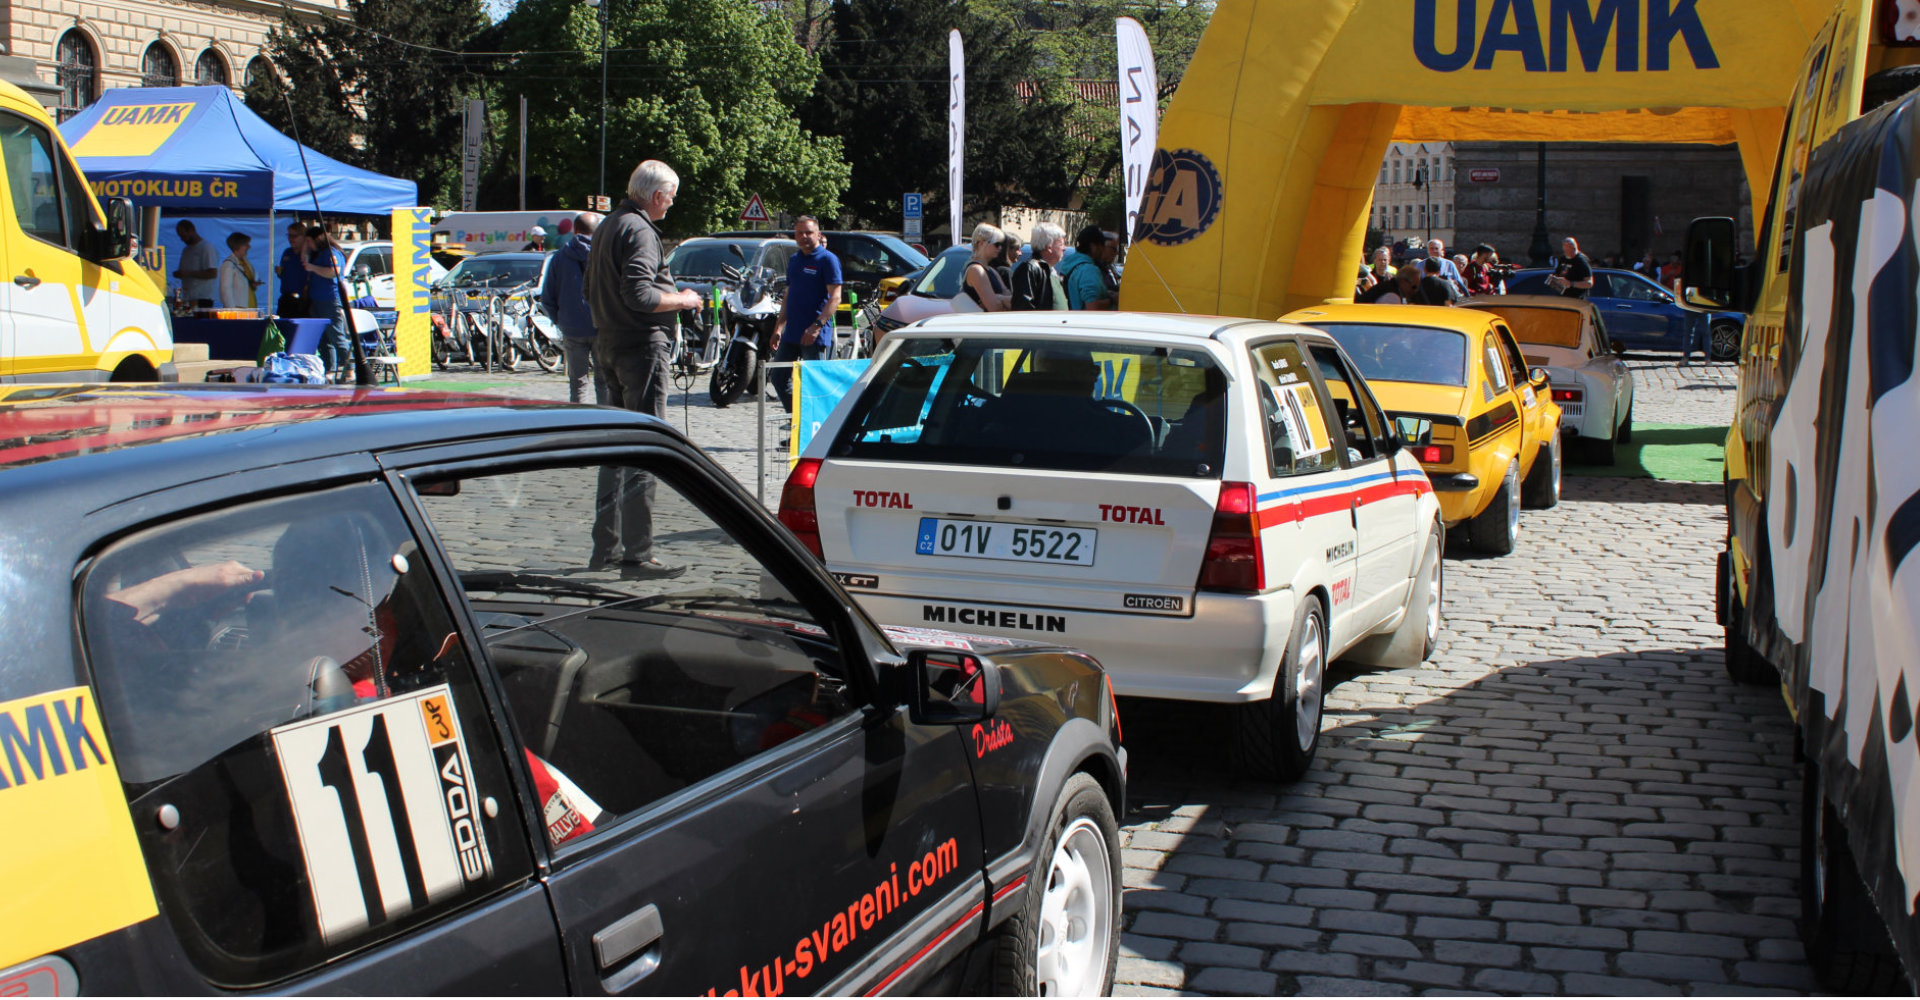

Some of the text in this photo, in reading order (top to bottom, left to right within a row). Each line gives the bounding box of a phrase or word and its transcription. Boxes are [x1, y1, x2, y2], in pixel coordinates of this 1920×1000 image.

[1413, 0, 1720, 72] UAMK
[102, 104, 189, 126] UAMK
[209, 178, 238, 198] ČR
[411, 209, 431, 314] UAMK
[853, 490, 913, 509] TOTAL
[1099, 504, 1165, 525] TOTAL
[920, 541, 933, 550] CZ
[940, 524, 1082, 561] 01V 5522
[1326, 540, 1354, 563] MICHELIN
[850, 577, 875, 585] GT
[1126, 597, 1180, 609] CITROËN
[923, 605, 1066, 632] MICHELIN
[972, 718, 1014, 759] Drásta
[317, 713, 430, 928] 11
[441, 752, 483, 881] EDDA
[699, 837, 958, 996] ku-svareni.com
